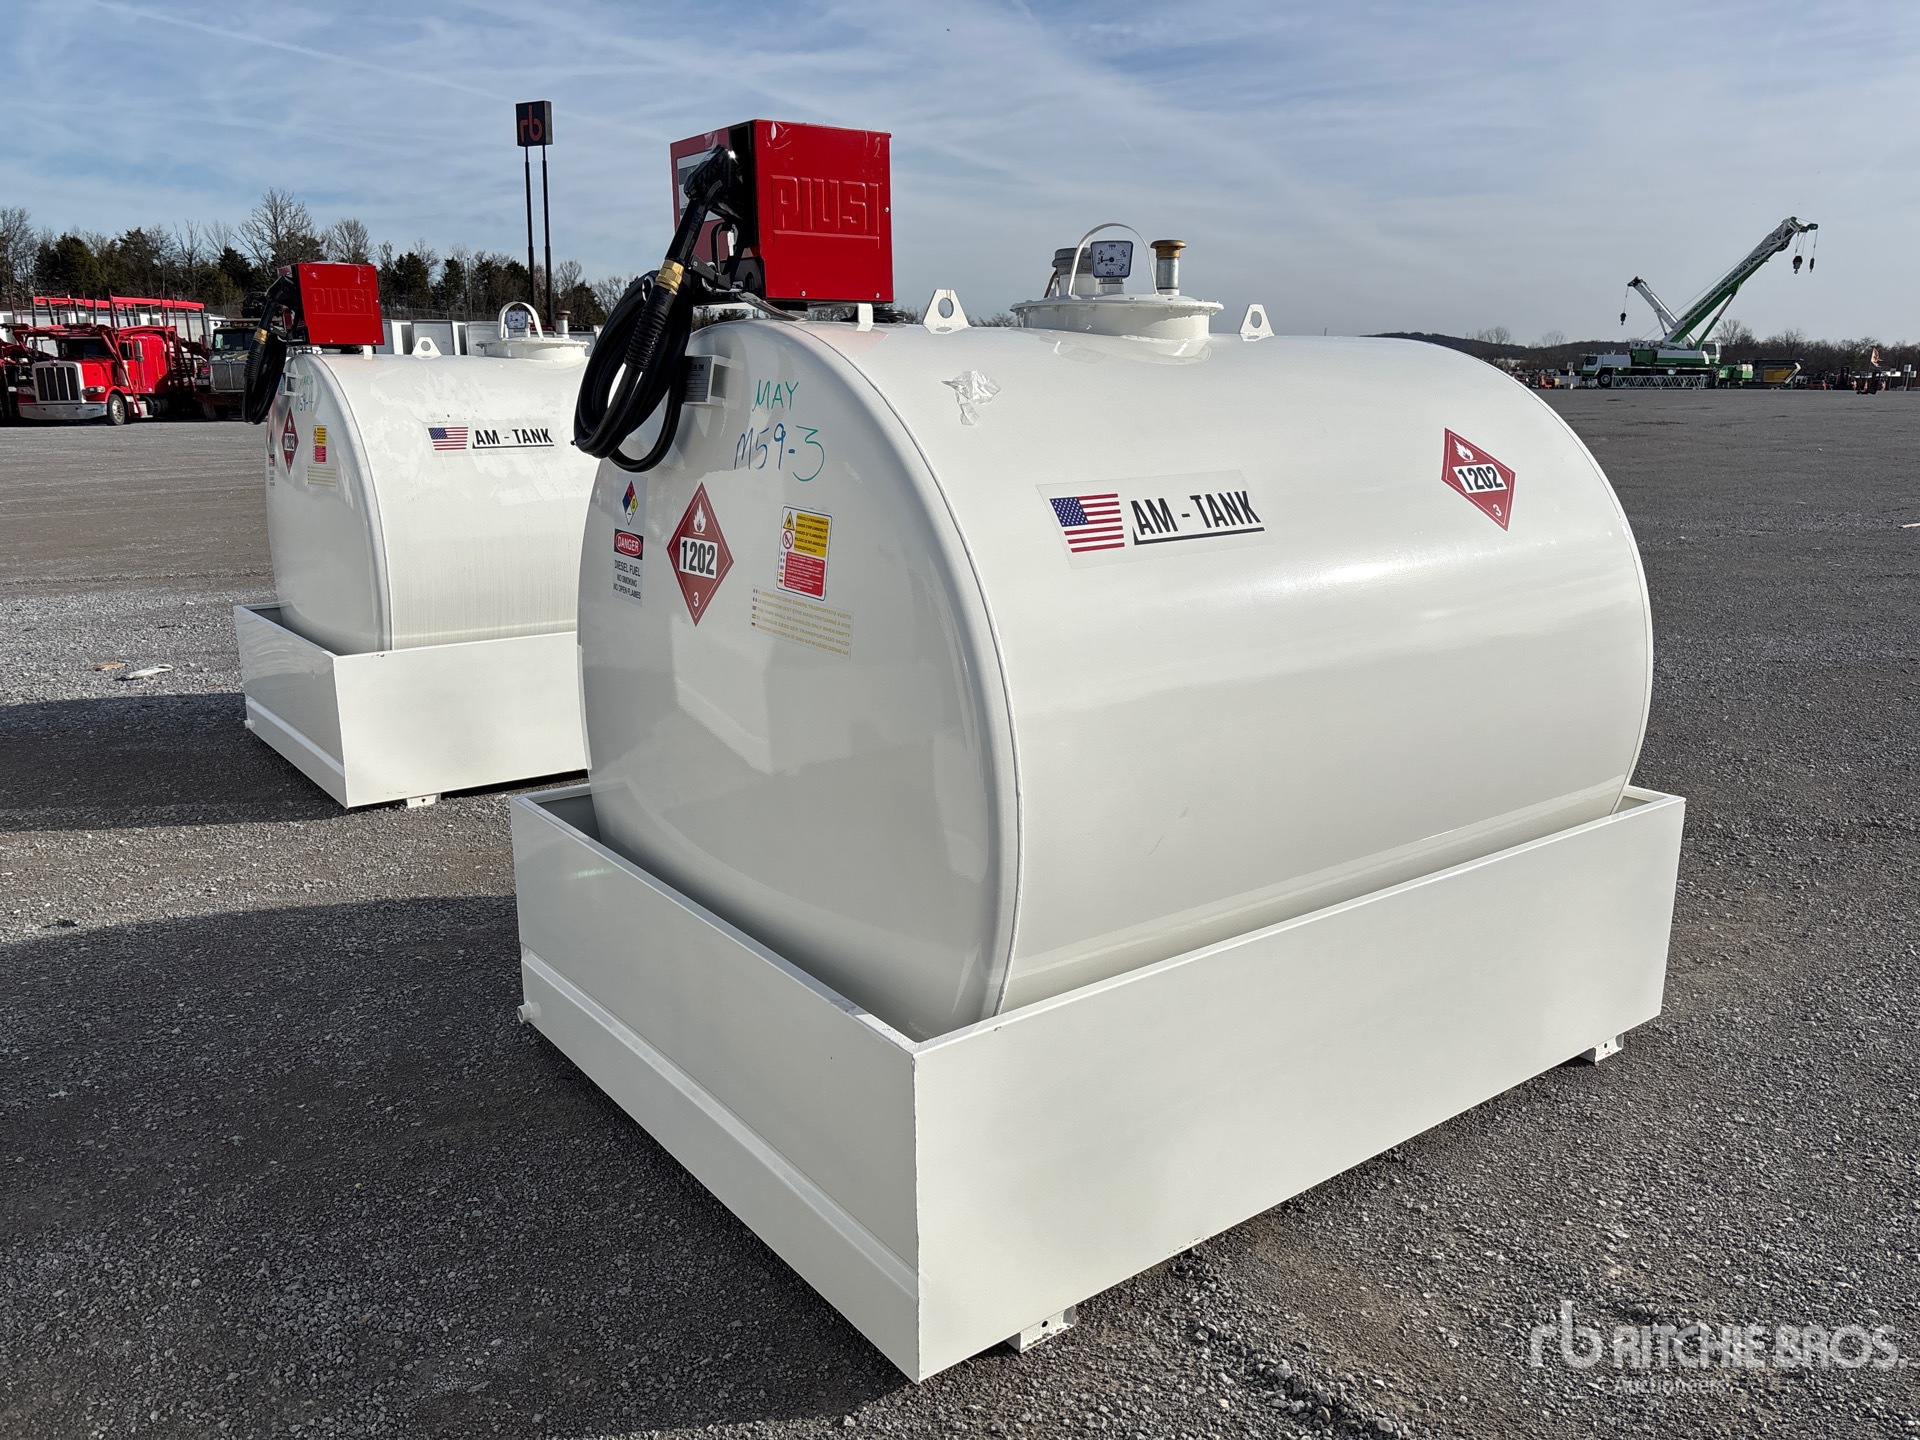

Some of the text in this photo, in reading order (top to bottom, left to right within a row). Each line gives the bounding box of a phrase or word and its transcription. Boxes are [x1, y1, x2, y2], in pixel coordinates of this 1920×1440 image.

[519, 104, 543, 143] rb
[770, 173, 880, 234] PIUSI
[752, 379, 800, 411] MAY
[475, 429, 501, 446] AM
[511, 428, 554, 444] TANK
[733, 422, 826, 483] M59-3
[1457, 465, 1504, 493] 1202
[1130, 497, 1179, 536] AM
[1189, 490, 1262, 530] TANK
[1492, 503, 1503, 517] 3
[617, 536, 639, 552] DANGER
[681, 540, 716, 576] 1202
[614, 559, 641, 577] DIESEL FUEL
[693, 591, 699, 608] 3
